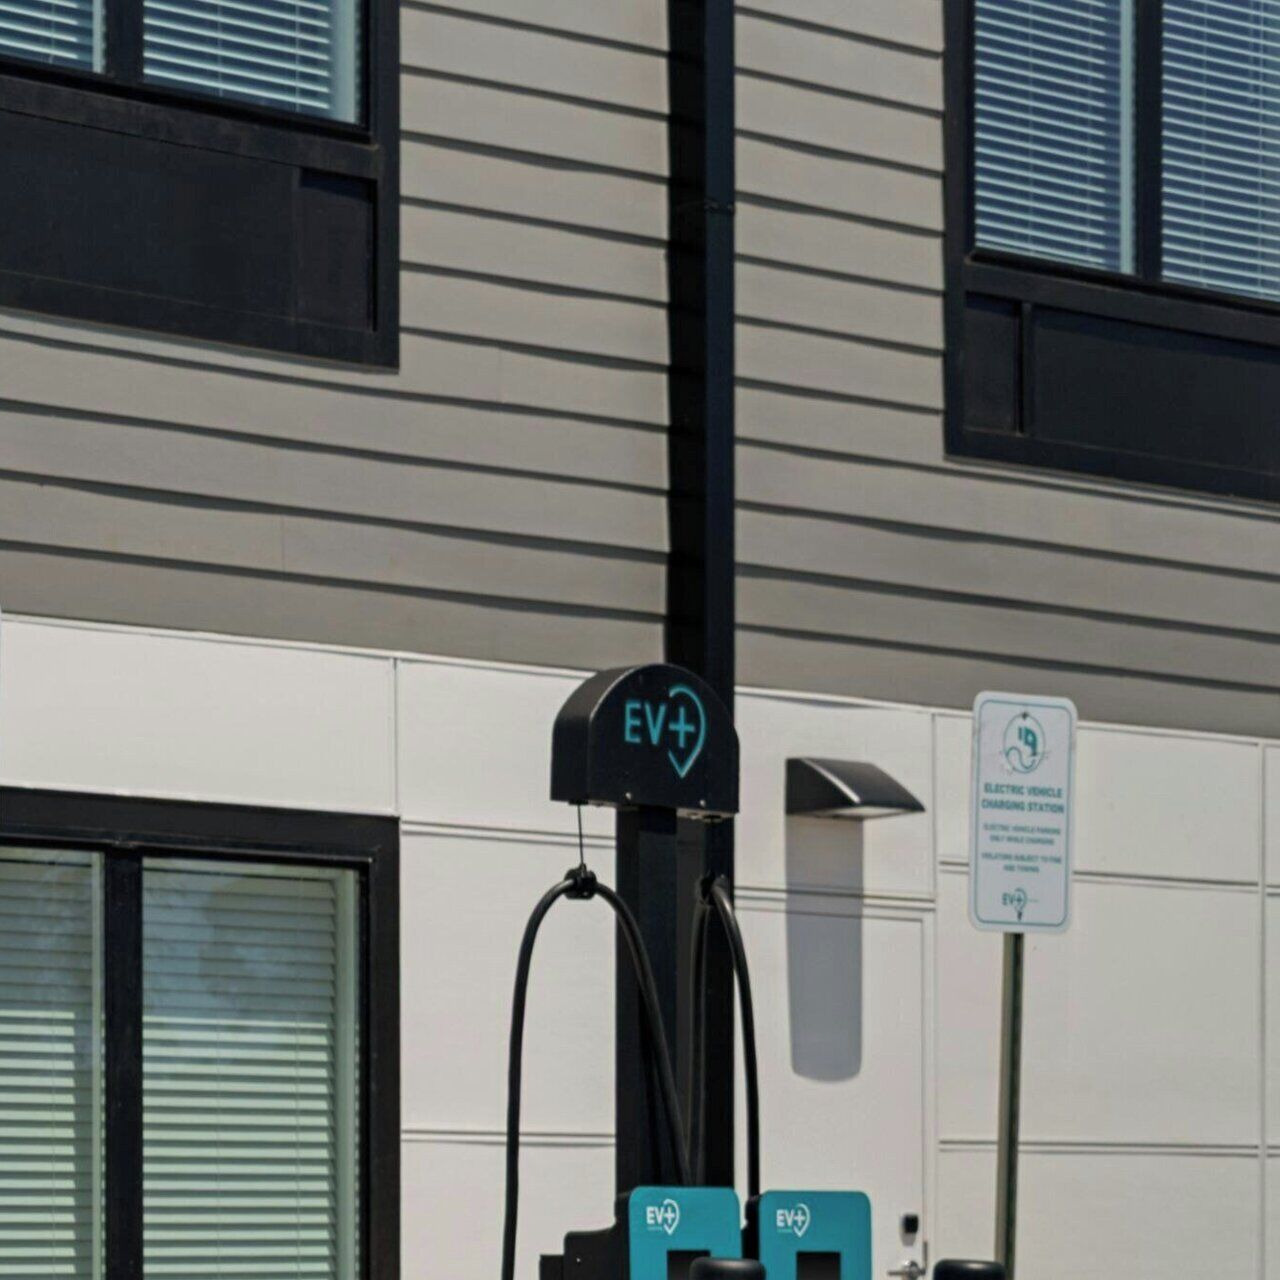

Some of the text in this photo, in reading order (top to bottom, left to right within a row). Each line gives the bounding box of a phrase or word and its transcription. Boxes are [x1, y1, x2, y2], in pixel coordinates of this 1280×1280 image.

[984, 782, 1062, 798] ELECTRIC VEHICLE
[981, 798, 1064, 813] CHARGING STATION
